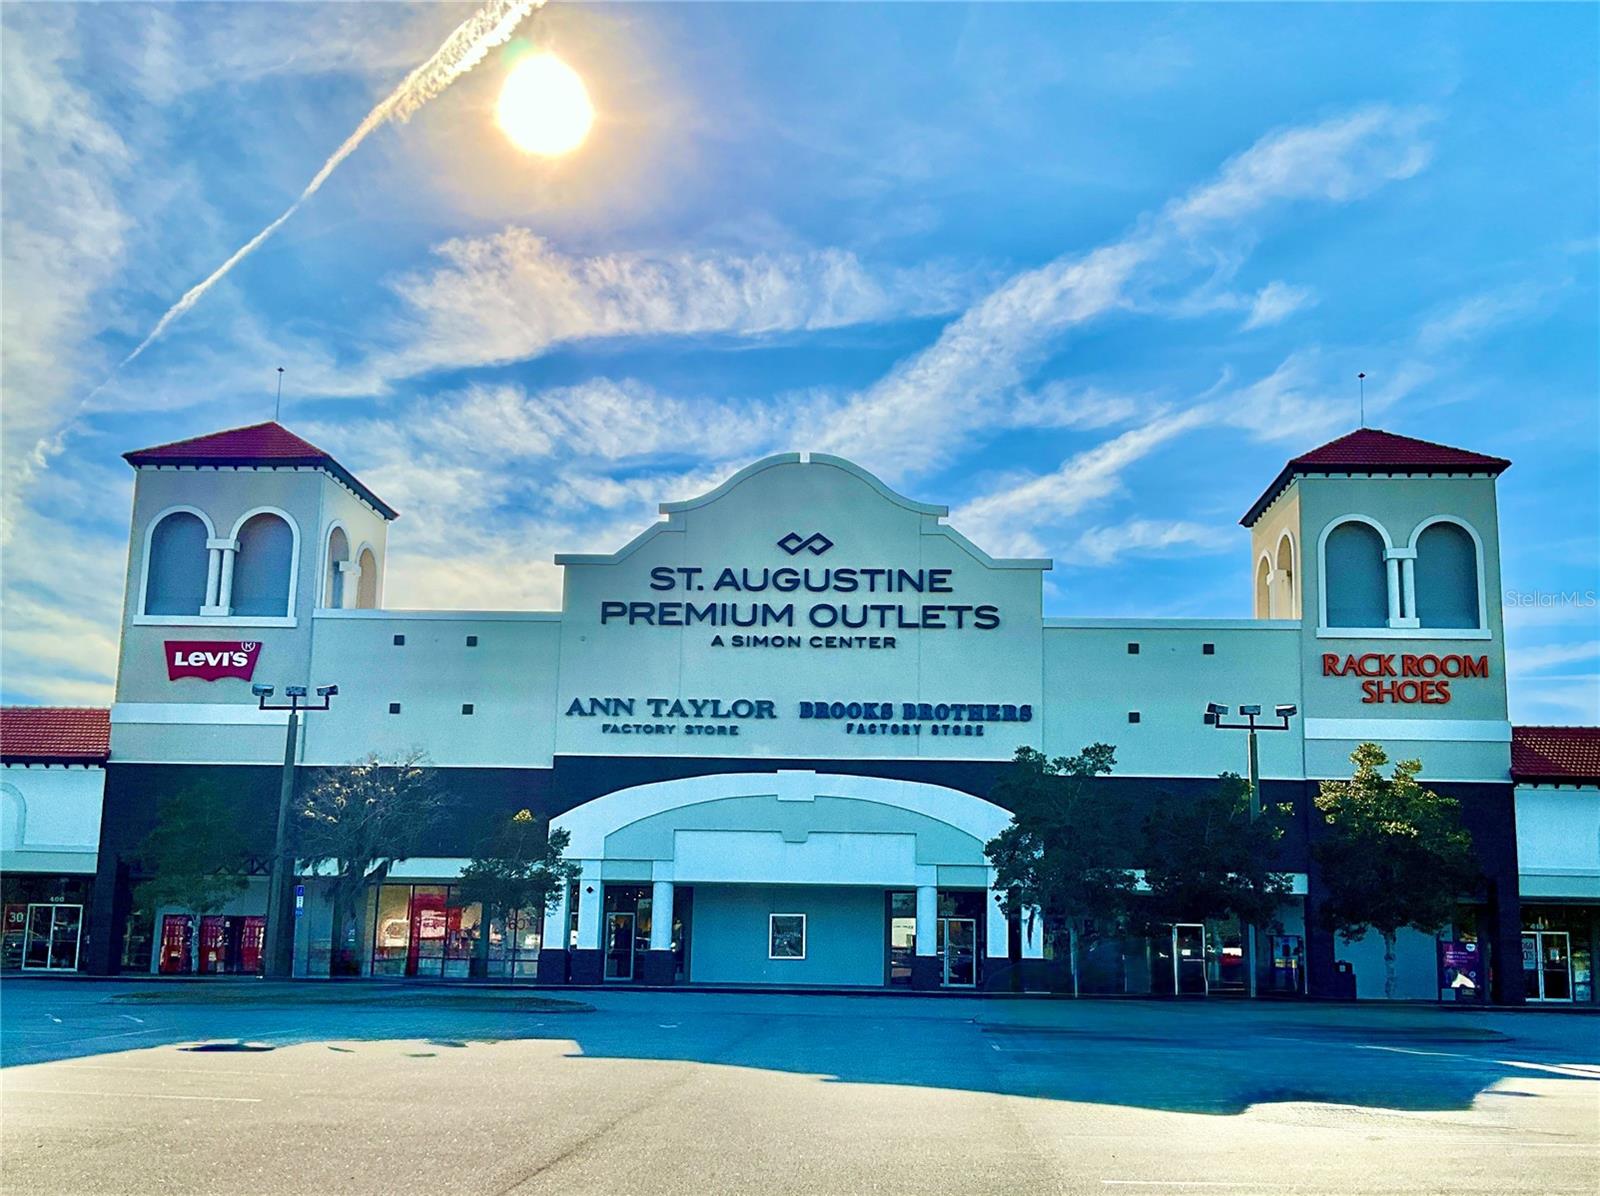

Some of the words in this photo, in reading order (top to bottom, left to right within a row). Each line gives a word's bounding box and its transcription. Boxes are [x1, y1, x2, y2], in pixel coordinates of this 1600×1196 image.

[649, 567, 703, 593] ST.
[713, 567, 953, 593] AUGUSTINE
[601, 601, 793, 626] PREMIUM
[809, 604, 1001, 630] OUTLETS
[711, 635, 725, 648] A
[732, 635, 800, 648] SIMON
[809, 636, 896, 649] CENTER
[1322, 653, 1397, 677] RACK
[1401, 654, 1489, 678] ROOM
[1361, 680, 1451, 704] SHOES
[565, 697, 636, 717] ANN
[647, 698, 777, 719] TAYLOR
[799, 701, 893, 720] BROOKS
[902, 703, 1033, 722] BROTHERS
[602, 723, 676, 735] FACTORY
[685, 724, 739, 736] STORE
[846, 723, 922, 736] FACTORY
[931, 724, 985, 737] STORE
